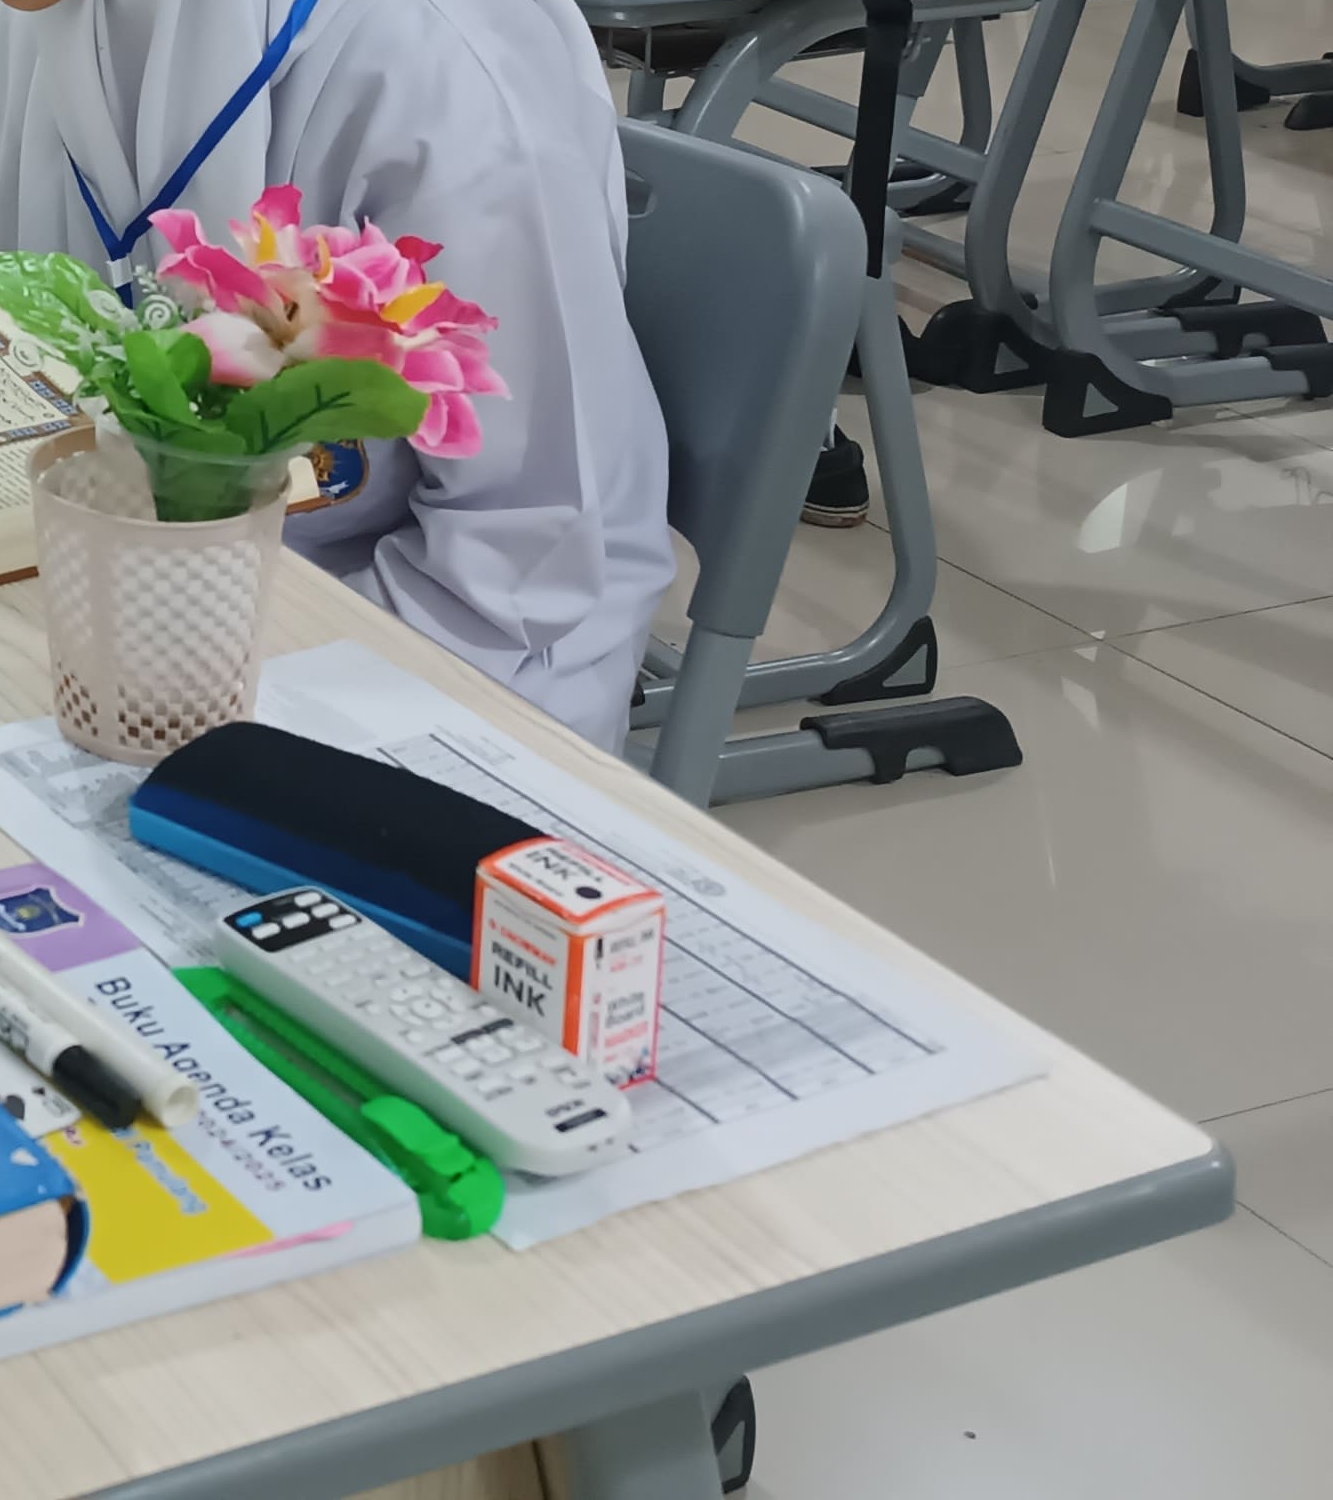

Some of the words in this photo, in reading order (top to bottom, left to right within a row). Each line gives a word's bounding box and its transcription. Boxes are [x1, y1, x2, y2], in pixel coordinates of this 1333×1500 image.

[491, 940, 553, 991] REFILL
[494, 964, 547, 1018] INK
[95, 975, 164, 1037] Buku
[153, 1041, 256, 1125] Agenda
[249, 1124, 332, 1191] Kelas
